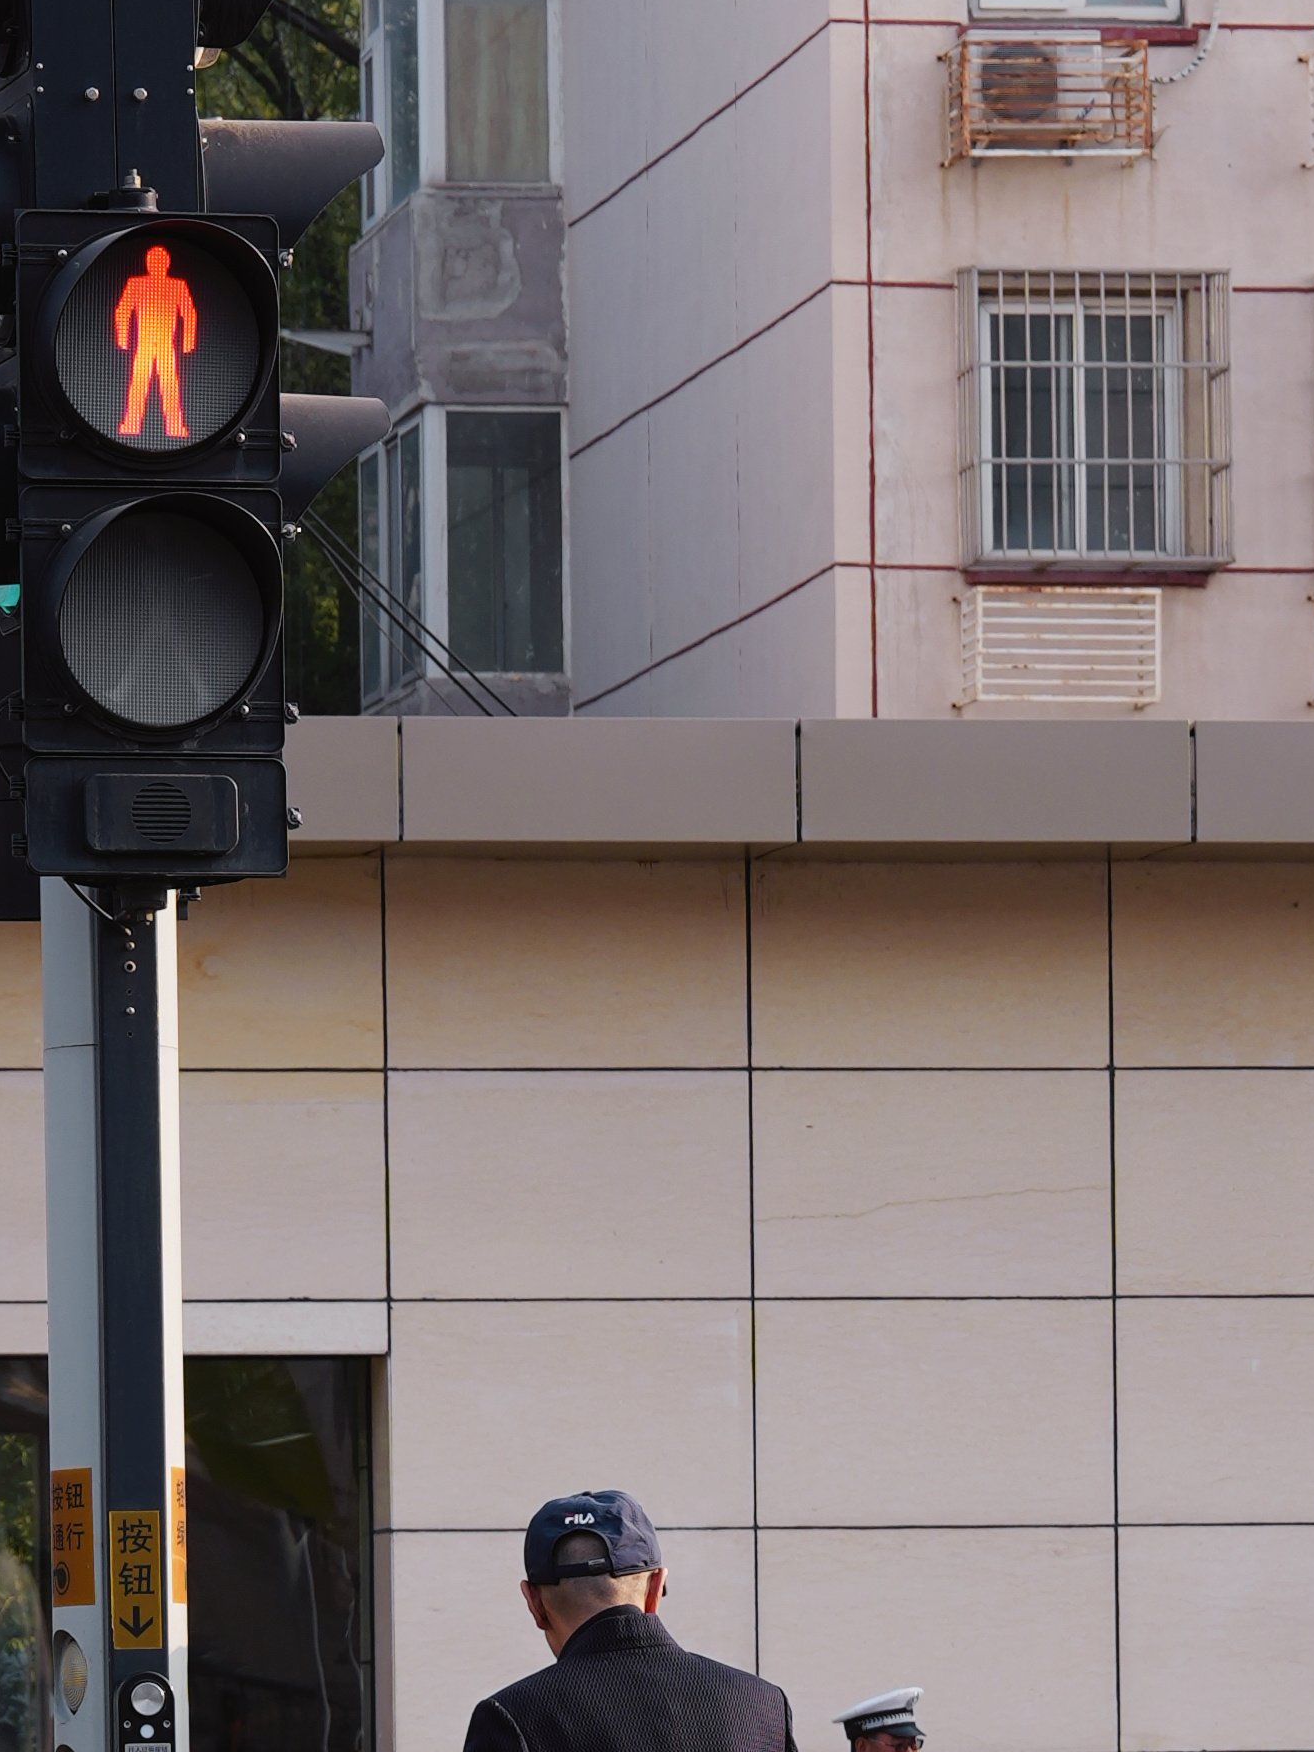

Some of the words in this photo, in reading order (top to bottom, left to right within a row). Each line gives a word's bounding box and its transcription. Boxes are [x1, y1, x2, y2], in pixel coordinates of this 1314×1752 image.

[52, 1483, 85, 1511] 按钮
[565, 1512, 595, 1525] FILA
[52, 1522, 85, 1551] 通行
[117, 1519, 154, 1596] 按钮
